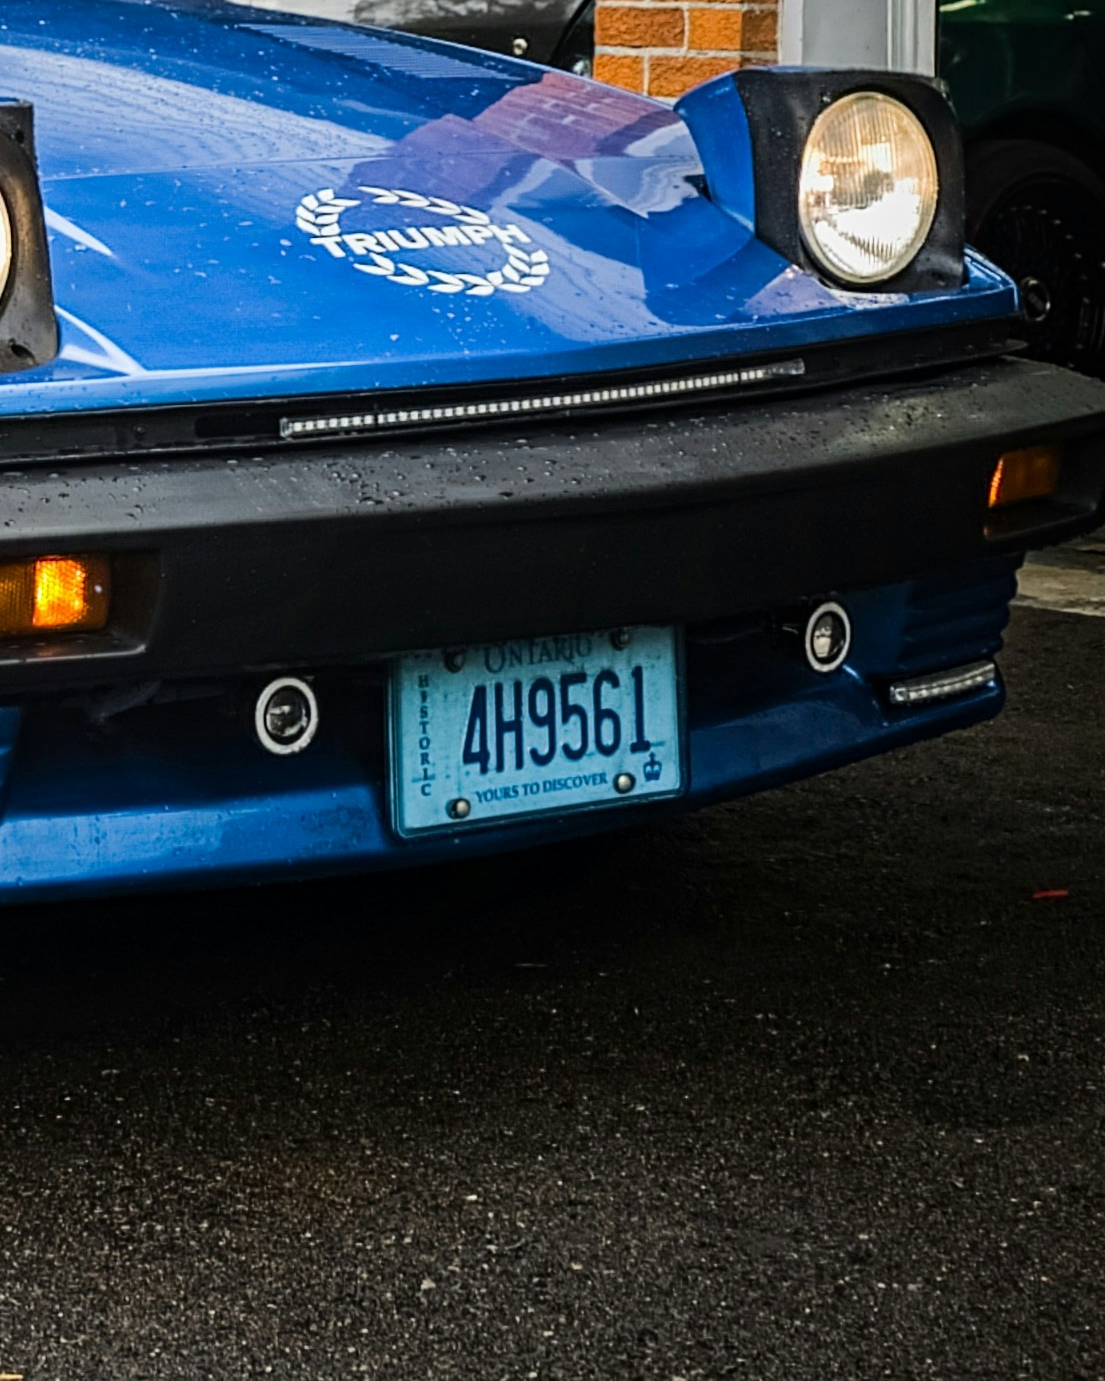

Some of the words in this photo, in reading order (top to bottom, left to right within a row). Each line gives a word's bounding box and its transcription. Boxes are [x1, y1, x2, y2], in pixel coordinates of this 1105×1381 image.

[309, 223, 532, 258] TRIUMPH
[484, 637, 594, 674] ONTARIO
[417, 674, 433, 797] HISTORIC
[462, 665, 652, 775] 4H9561
[475, 786, 520, 805] YOURS
[522, 782, 540, 796] TO
[542, 771, 609, 791] DISCOVER
